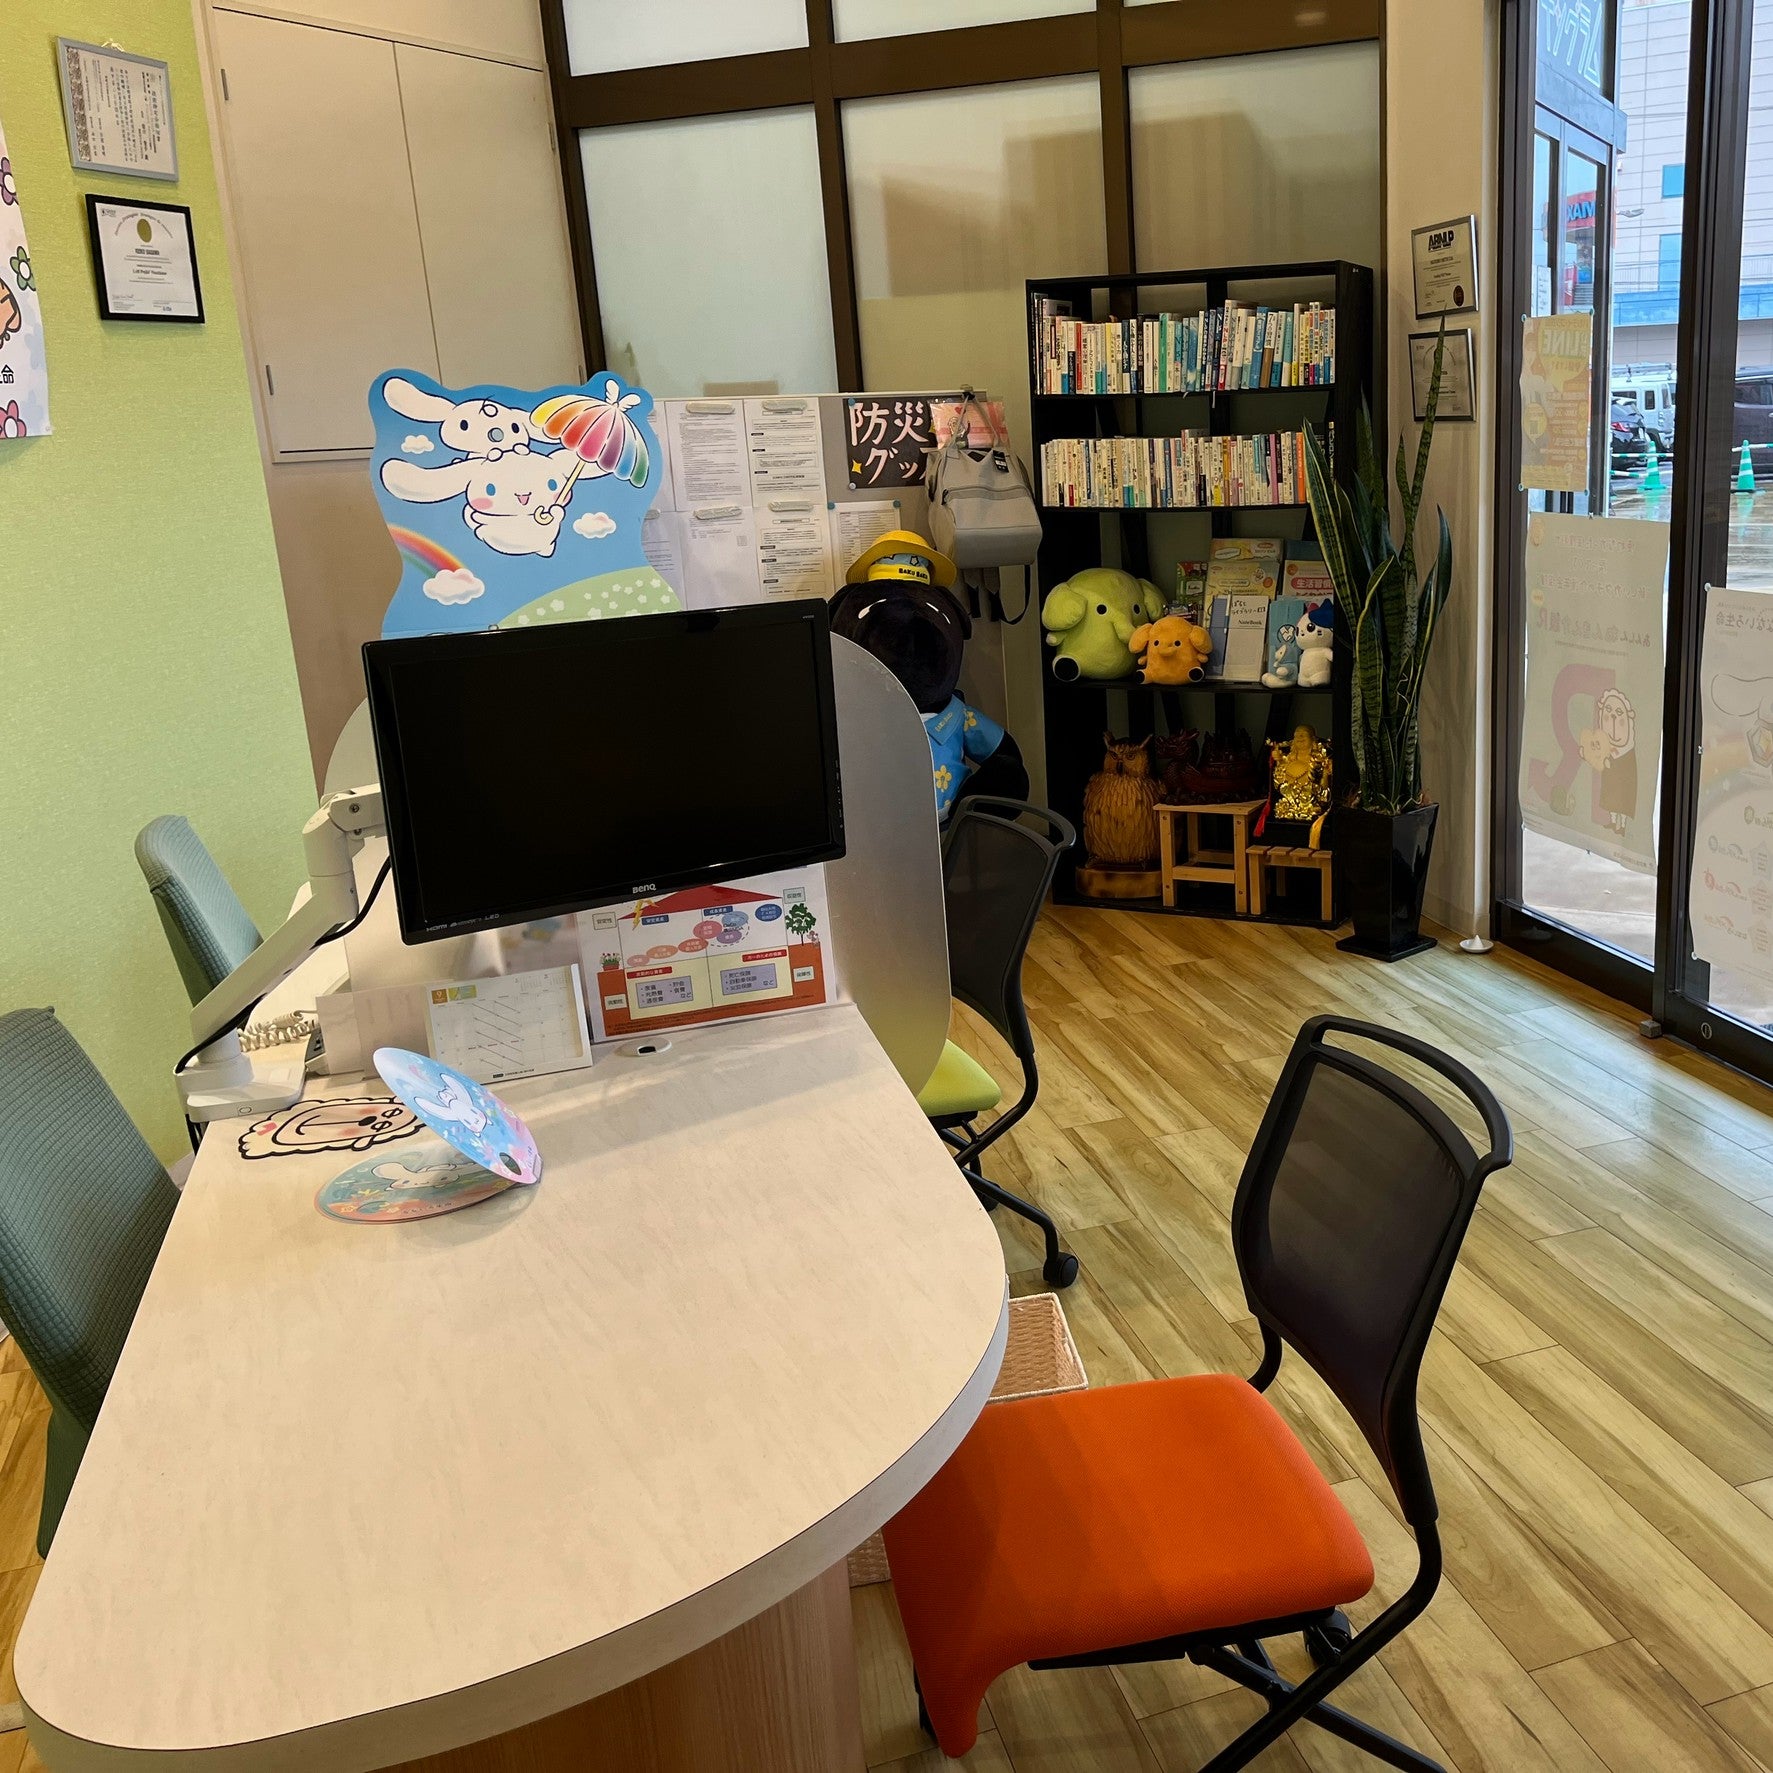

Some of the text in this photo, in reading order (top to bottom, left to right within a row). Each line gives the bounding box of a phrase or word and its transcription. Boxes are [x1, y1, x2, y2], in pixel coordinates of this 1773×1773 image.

[848, 401, 930, 446] 防災
[864, 446, 930, 485] グッ
[632, 882, 657, 894] BenQ
